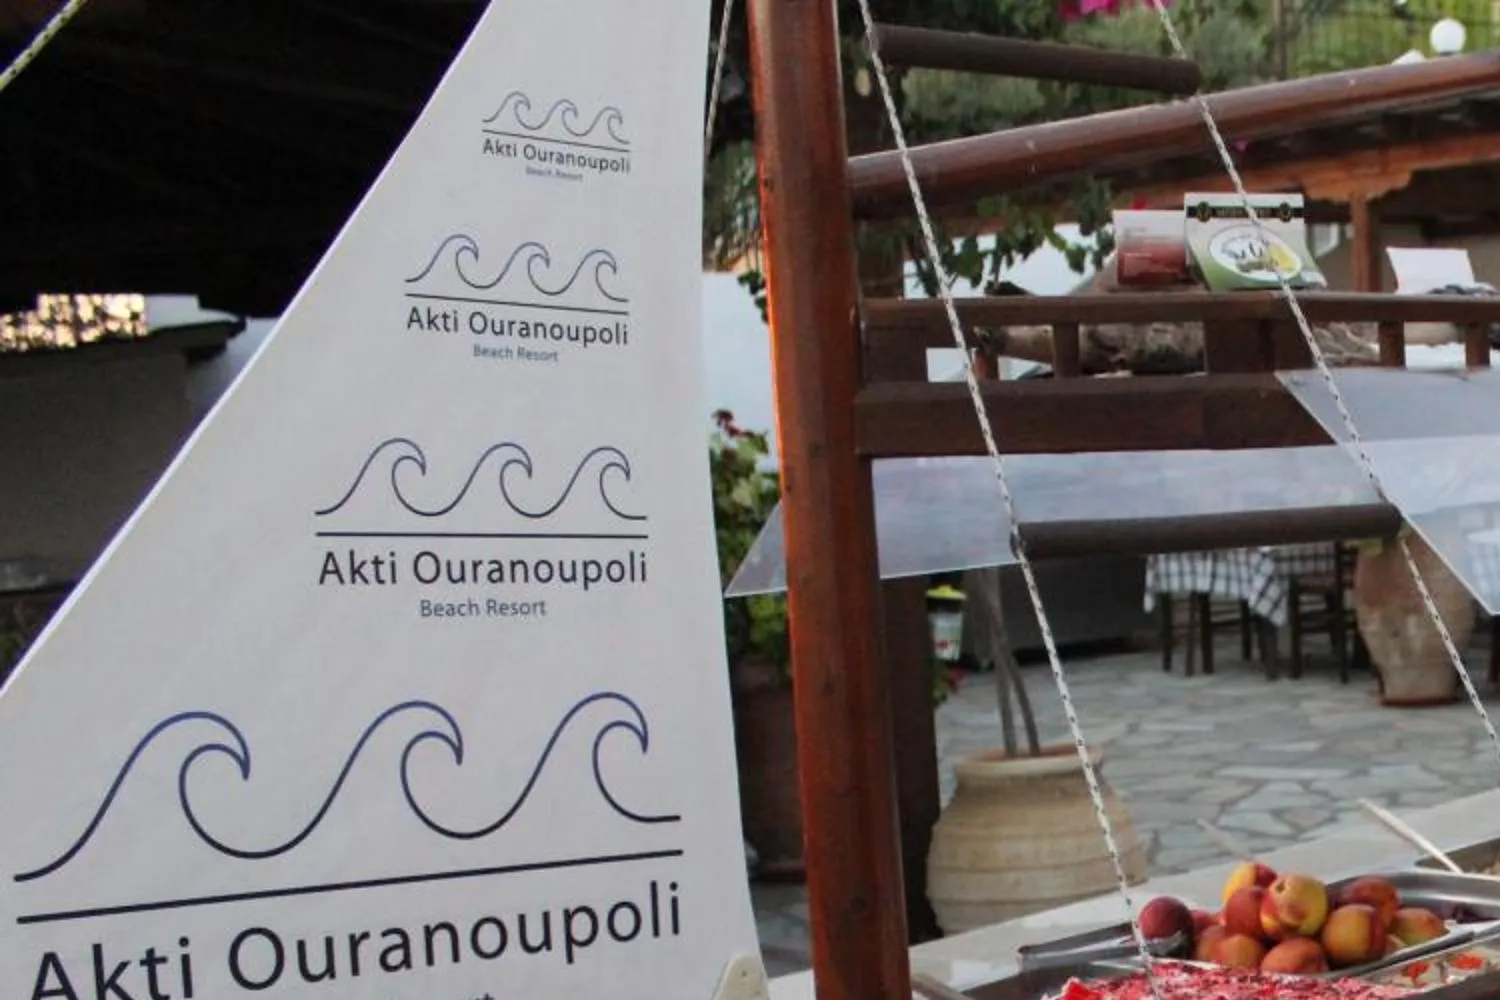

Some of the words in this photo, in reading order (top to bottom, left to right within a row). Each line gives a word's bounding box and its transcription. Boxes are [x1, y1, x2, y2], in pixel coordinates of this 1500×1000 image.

[482, 137, 518, 158] Akti
[522, 143, 631, 174] Ouranoupoli
[406, 305, 459, 334] Akti
[468, 310, 628, 349] Ouranoupoli
[472, 343, 514, 360] Beach
[516, 345, 560, 363] Resort
[318, 548, 398, 586] Akti
[412, 549, 647, 592] Ouranoupoli
[419, 598, 481, 618] Beach
[485, 598, 546, 617] Resort
[227, 881, 683, 991] Ouranoupoli
